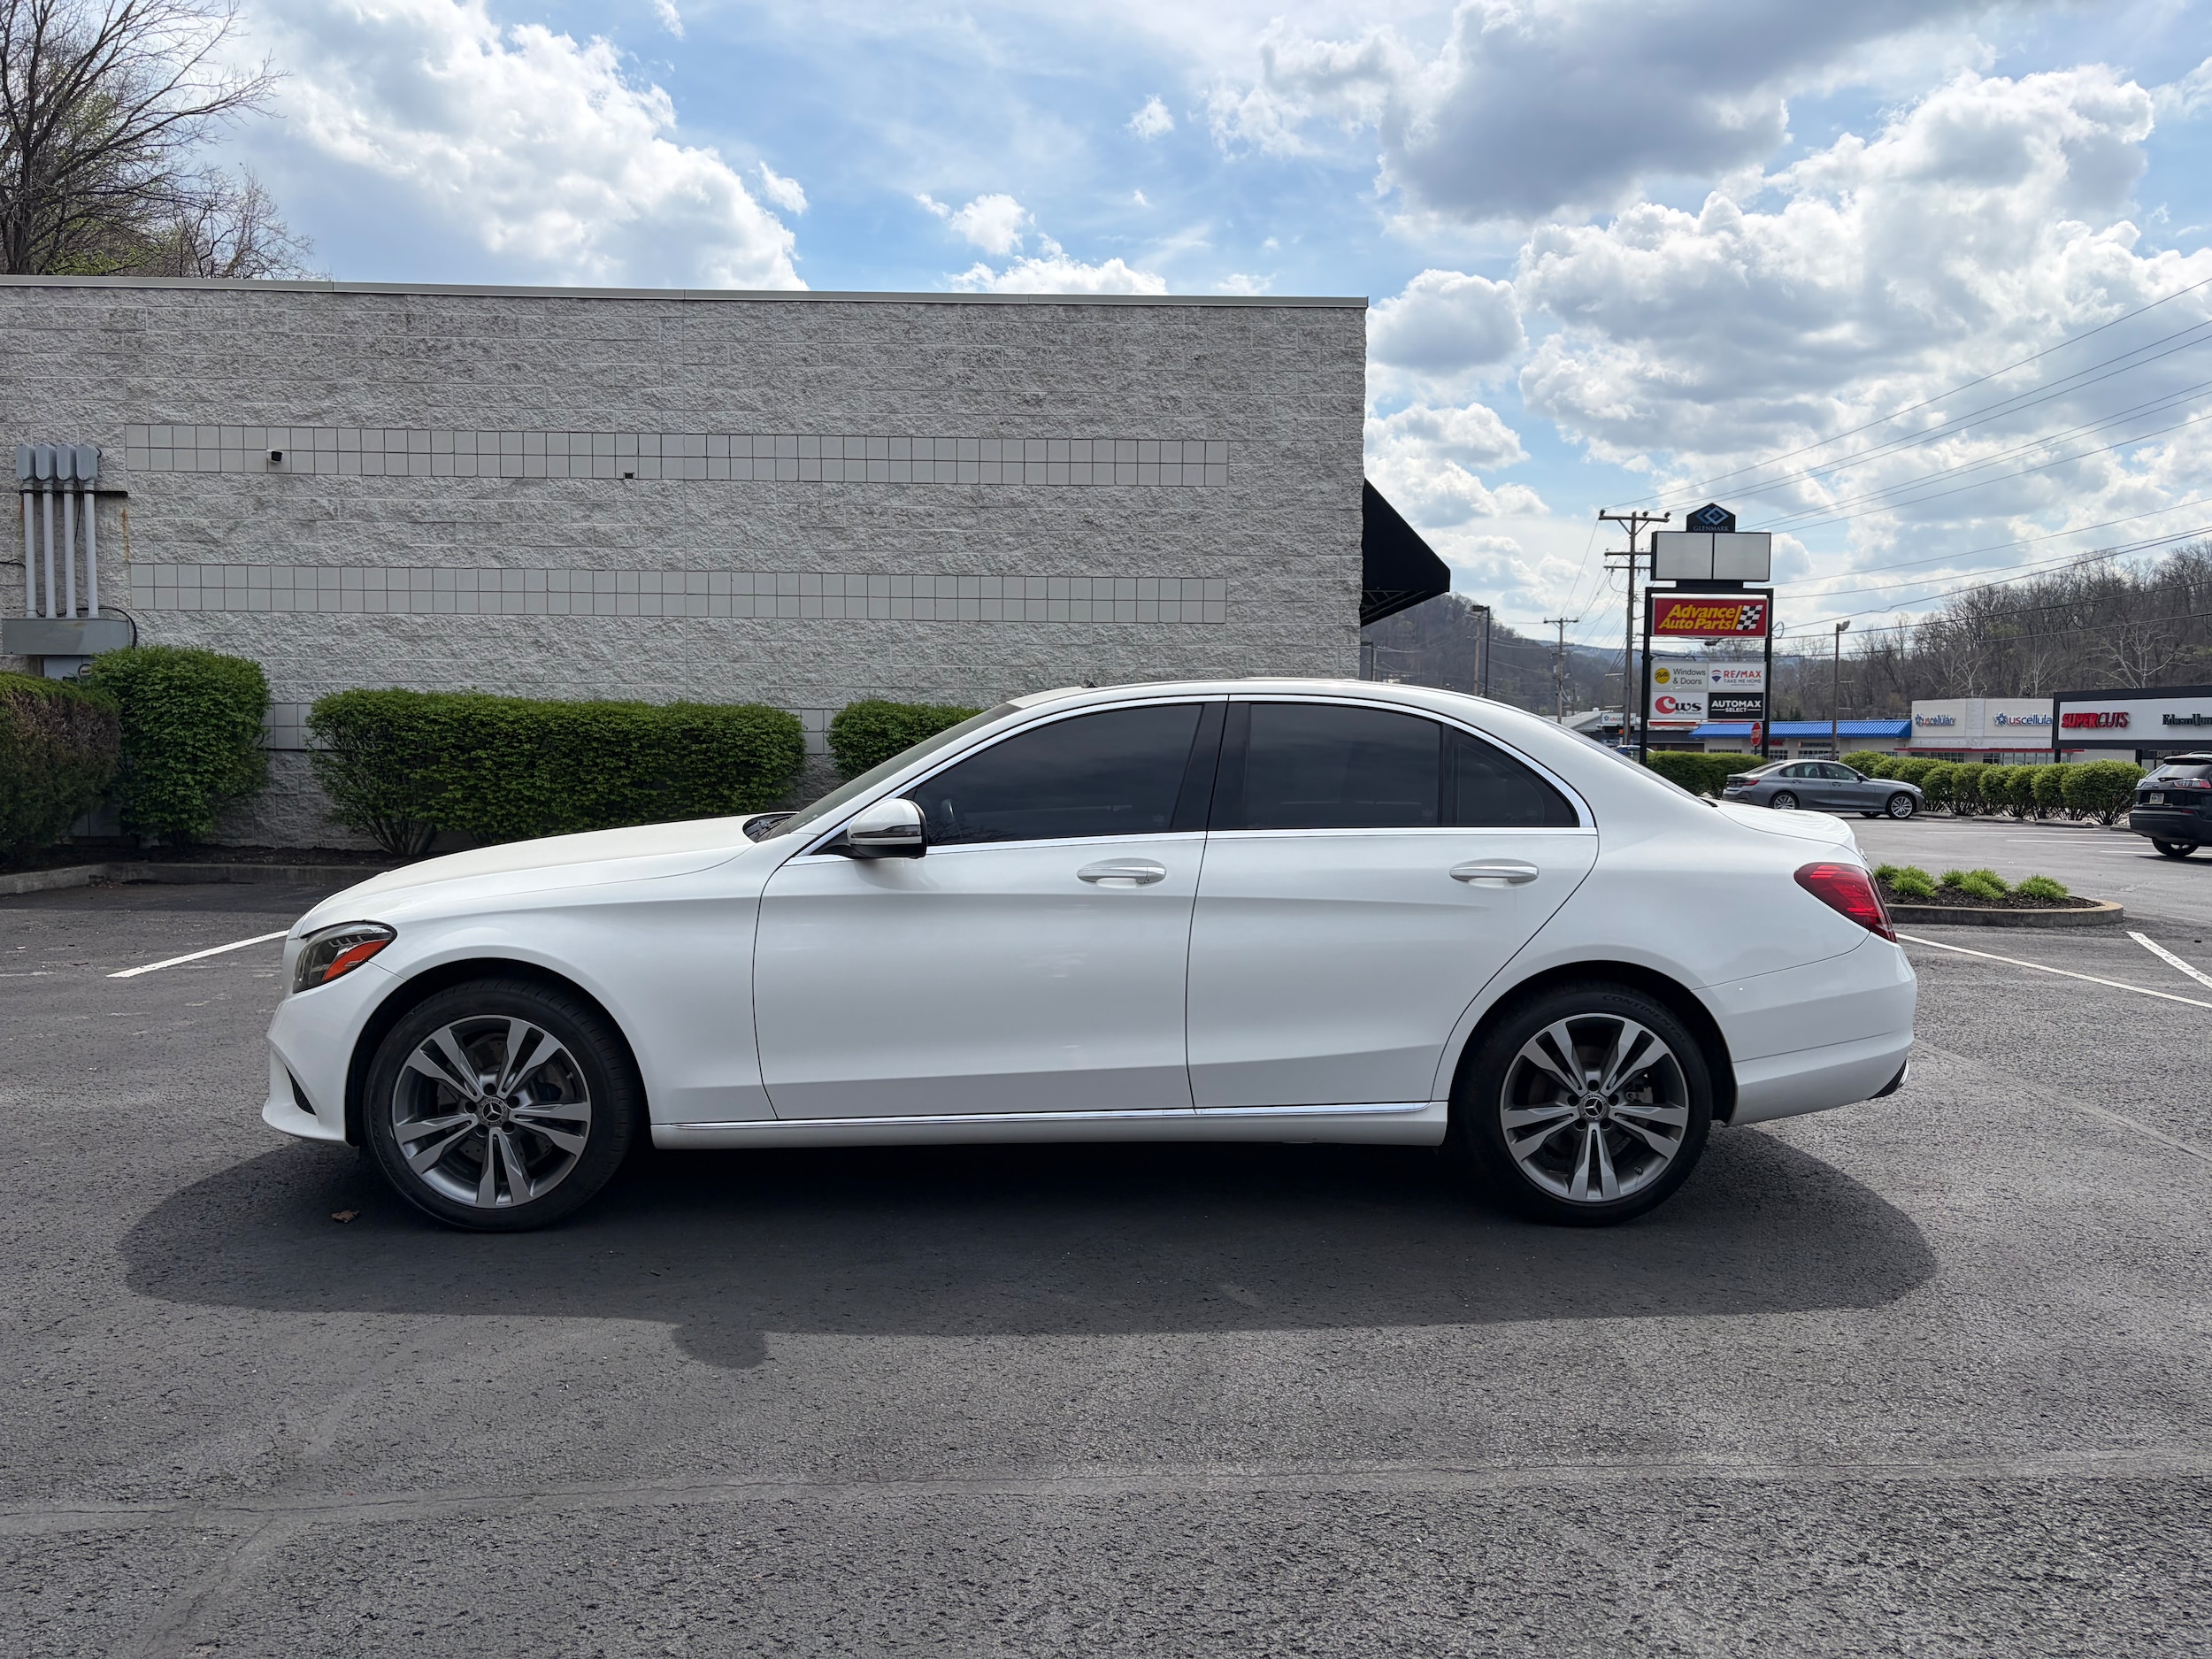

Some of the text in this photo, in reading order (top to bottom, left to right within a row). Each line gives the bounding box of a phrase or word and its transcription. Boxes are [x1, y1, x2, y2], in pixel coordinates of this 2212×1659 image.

[1667, 604, 1736, 618] Advance
[1658, 618, 1733, 630] Auto Parts
[1724, 670, 1762, 679] RE/MAX
[2008, 714, 2053, 726] uscellula
[2061, 712, 2129, 728] SUPERCUTS
